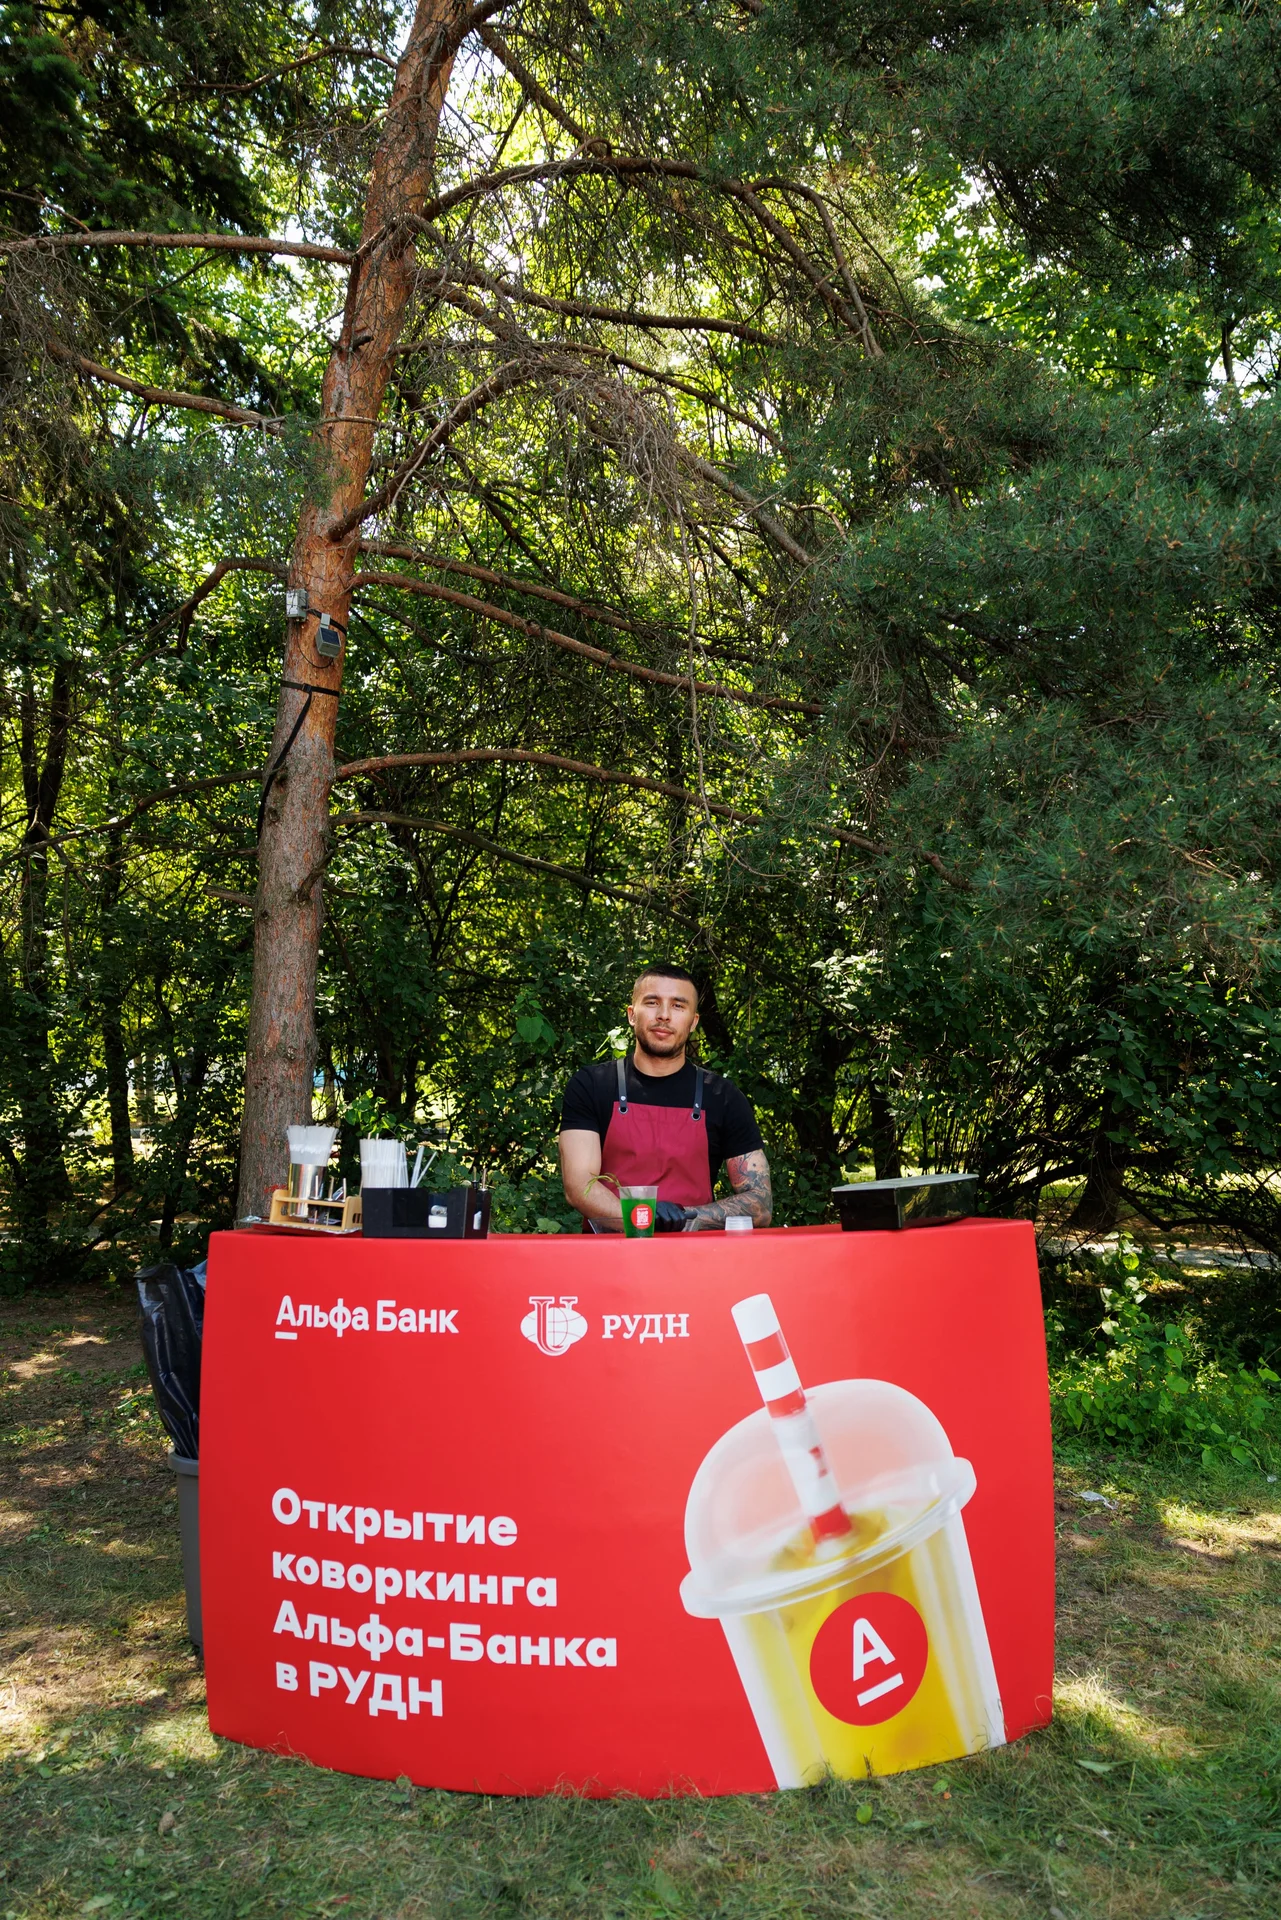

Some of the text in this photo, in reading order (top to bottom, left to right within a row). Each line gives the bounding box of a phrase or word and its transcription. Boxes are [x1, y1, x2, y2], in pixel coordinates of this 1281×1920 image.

[274, 1295, 460, 1341] Альфа Банк
[601, 1313, 691, 1345] РУДН
[271, 1487, 518, 1545] Открытие
[272, 1551, 558, 1607] коворкинга
[273, 1599, 618, 1668] Альфа-Банка
[275, 1660, 443, 1721] в РУДН
